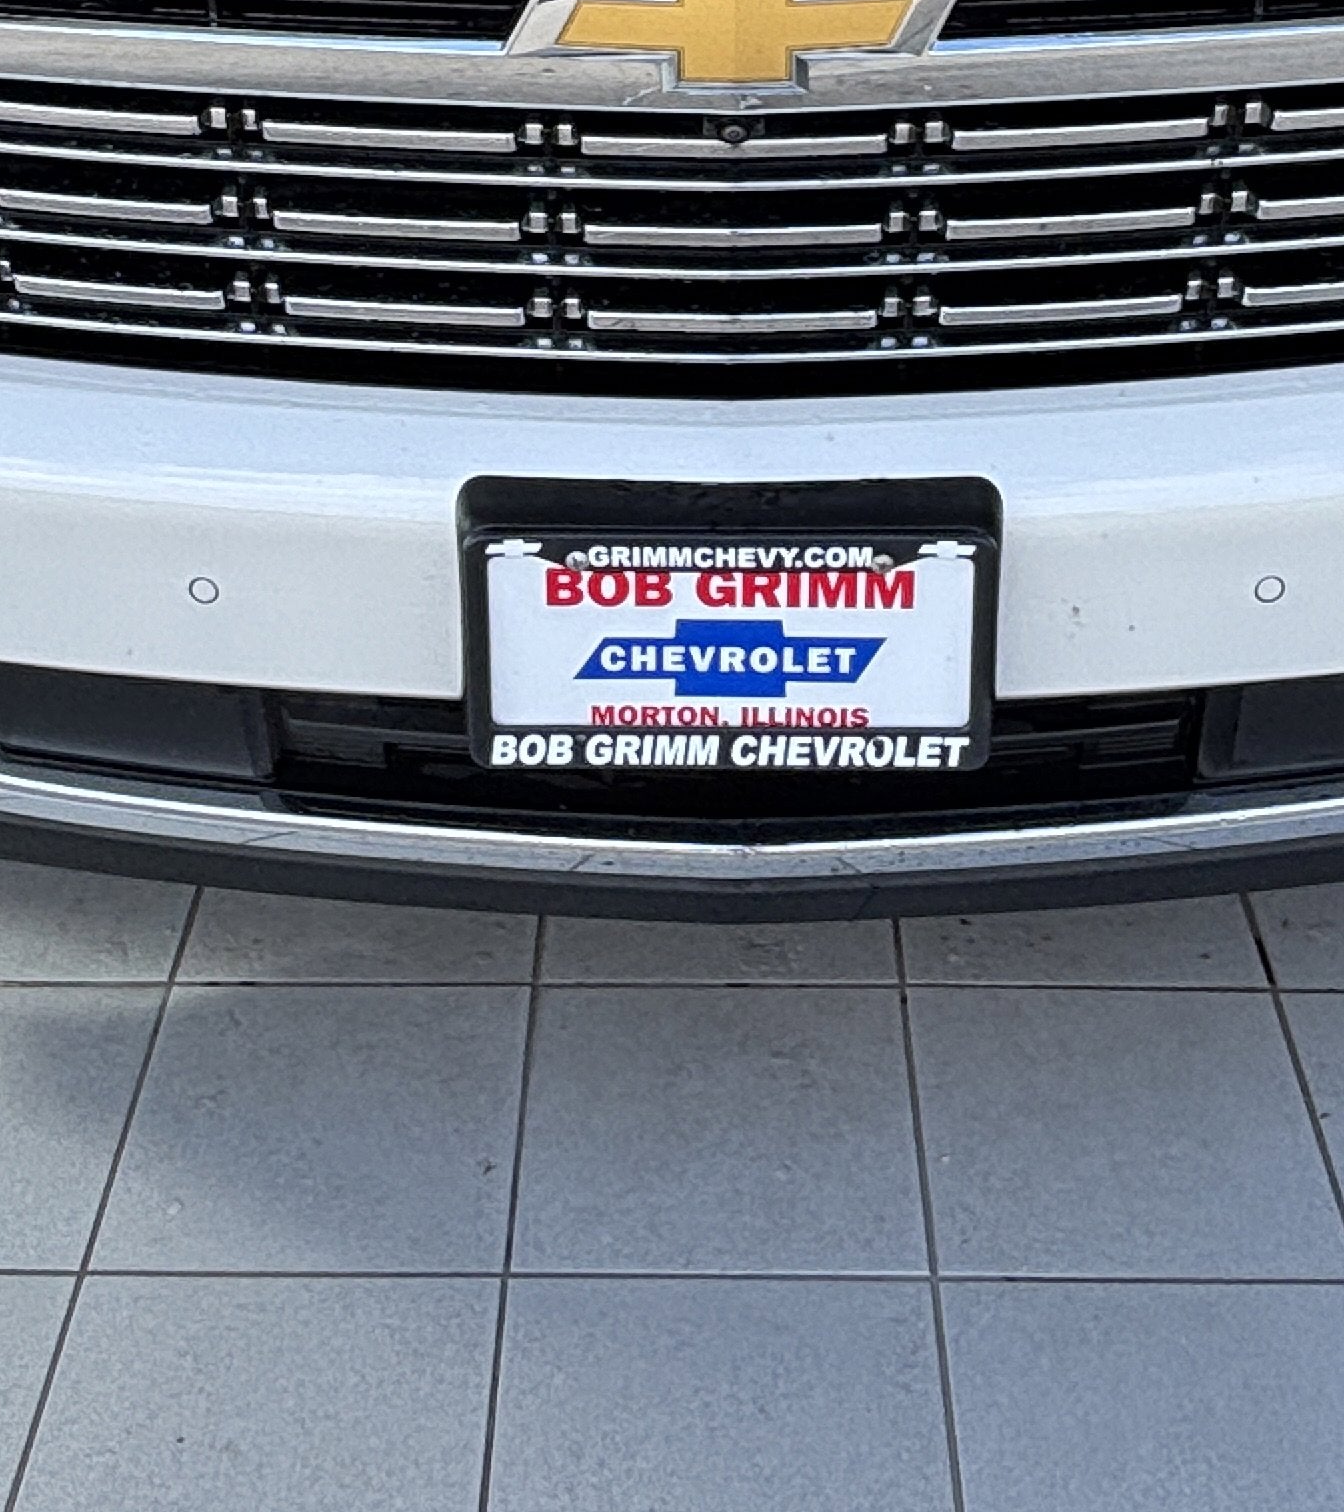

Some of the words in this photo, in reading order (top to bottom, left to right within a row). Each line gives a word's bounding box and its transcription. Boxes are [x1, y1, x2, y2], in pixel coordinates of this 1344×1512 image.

[587, 544, 874, 569] GRIMMCHEVY.COM
[546, 568, 673, 607] BOB
[696, 570, 916, 609] GRIMM
[600, 644, 856, 675] CHEVROLET
[740, 706, 870, 728] ILLINOIS
[491, 734, 573, 766] BOB
[585, 734, 720, 766] GRIMM
[730, 735, 970, 768] CHEVROLET
